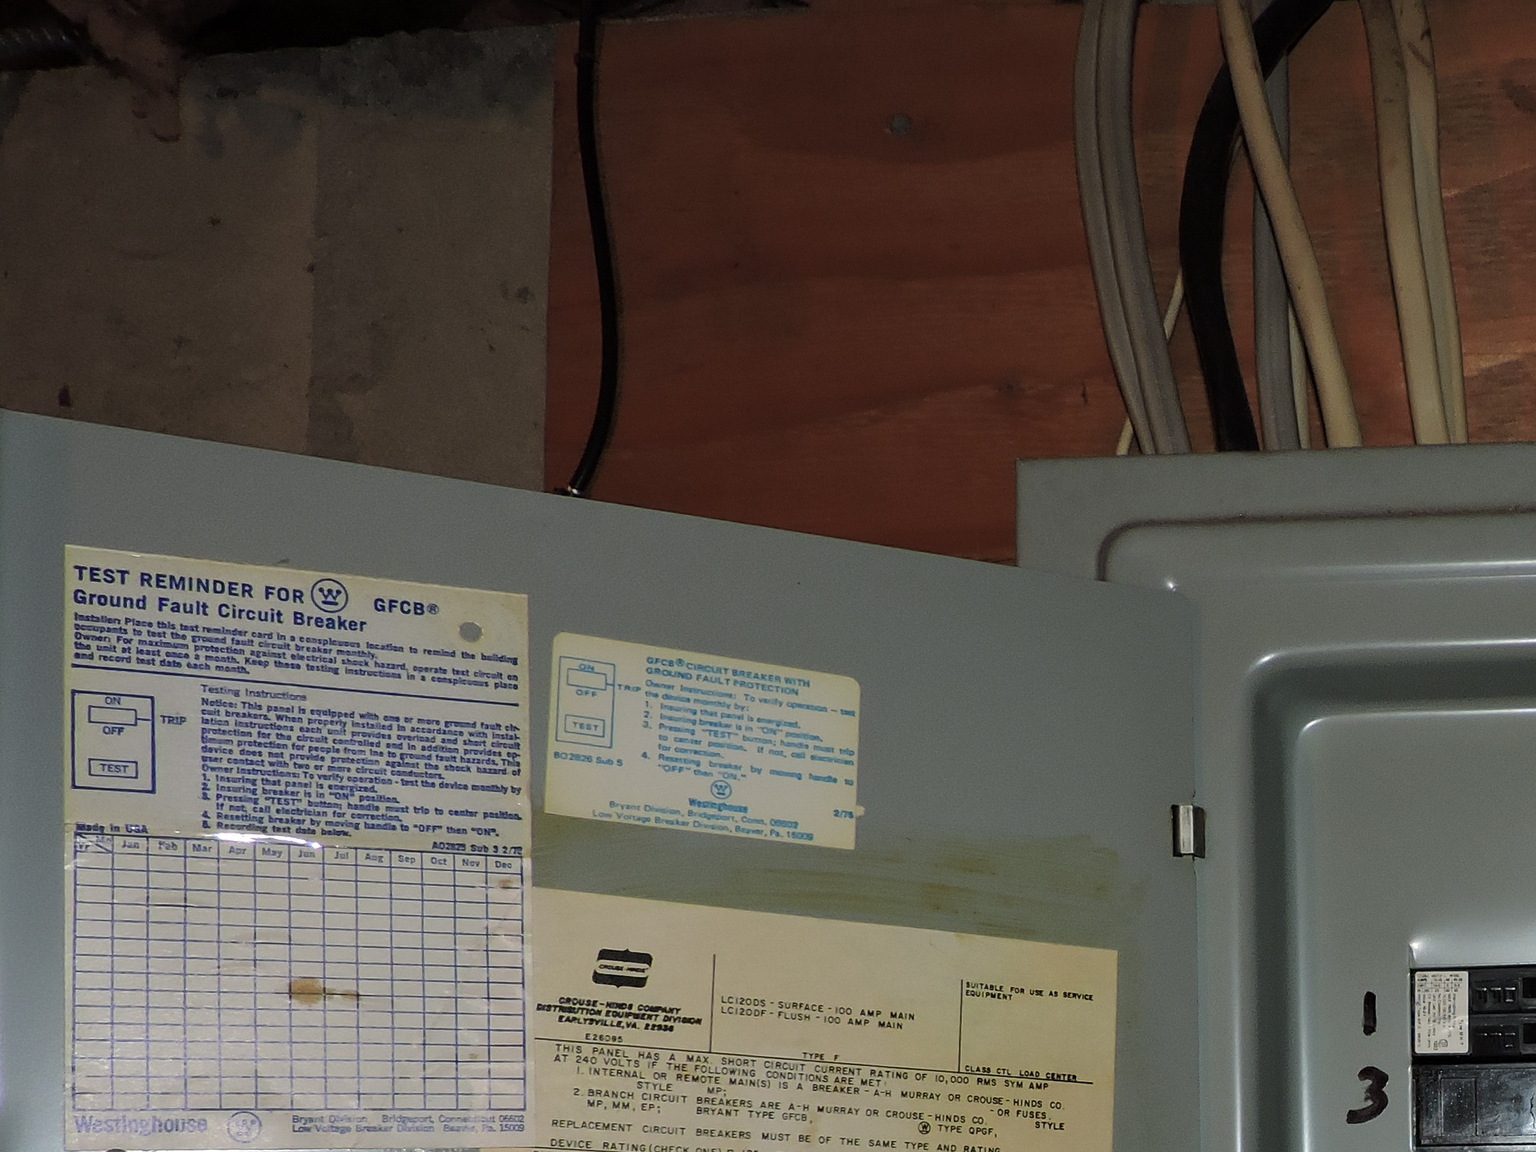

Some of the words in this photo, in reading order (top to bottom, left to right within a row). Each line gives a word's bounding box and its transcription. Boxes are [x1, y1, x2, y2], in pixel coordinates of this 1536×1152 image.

[73, 565, 130, 585] TEST
[140, 572, 254, 599] REMINDER
[264, 585, 304, 604] FOR
[73, 588, 147, 610] Ground
[158, 596, 209, 617] Fault
[218, 603, 284, 624] Circuit
[293, 610, 368, 632] Breaker
[579, 664, 595, 672] ON
[646, 667, 692, 680] GROUND
[696, 674, 730, 685] FAULT
[734, 680, 798, 696] PROTECTION
[200, 684, 241, 698] Testing
[245, 688, 307, 701] Instructions
[576, 689, 597, 698] OFF
[618, 684, 641, 693] TRIP
[105, 697, 121, 705] ON
[160, 715, 187, 725] TRIP
[103, 726, 125, 736] OFF
[573, 721, 599, 731] TEST
[101, 763, 129, 773] TEST
[122, 840, 140, 850] Jan
[192, 844, 212, 853] Mar
[228, 846, 247, 856] Apr
[262, 848, 283, 858] May
[398, 855, 416, 865] Sep
[431, 857, 447, 866] Oct
[462, 859, 480, 867] Nov
[495, 860, 513, 869] Dec
[778, 1001, 824, 1013] SURFACE
[835, 1006, 852, 1016] 100
[859, 1009, 882, 1017] AMP
[890, 1011, 915, 1021] MAIN
[1362, 991, 1377, 1036] 1
[802, 1052, 825, 1061] TYPE
[555, 1043, 582, 1054] THIS
[592, 1047, 629, 1058] PANEL
[638, 1051, 660, 1061] HAS
[668, 1053, 676, 1061] A
[721, 1057, 757, 1067] SHORT
[764, 1060, 806, 1071] CIRCUIT
[814, 1064, 862, 1076] CURRENT
[869, 1069, 908, 1080] RATING
[914, 1073, 928, 1081] OF
[935, 1074, 969, 1085] 10,000
[976, 1077, 997, 1087] RMS
[1004, 1079, 1023, 1089] SYM
[1028, 1081, 1049, 1091] AMP
[1346, 1066, 1389, 1124] 3
[74, 1115, 207, 1136] Westinghouse
[551, 1119, 633, 1132] REPLACEMENT
[642, 1125, 686, 1135] CIRCUIT
[696, 1128, 751, 1140] BREAKERS
[761, 1132, 791, 1142] MUST
[798, 1134, 811, 1143] BE
[818, 1136, 832, 1144] OF
[839, 1137, 860, 1146] THE
[869, 1139, 897, 1149] SAME
[904, 1141, 929, 1151] TYPE
[936, 1144, 957, 1152] AND
